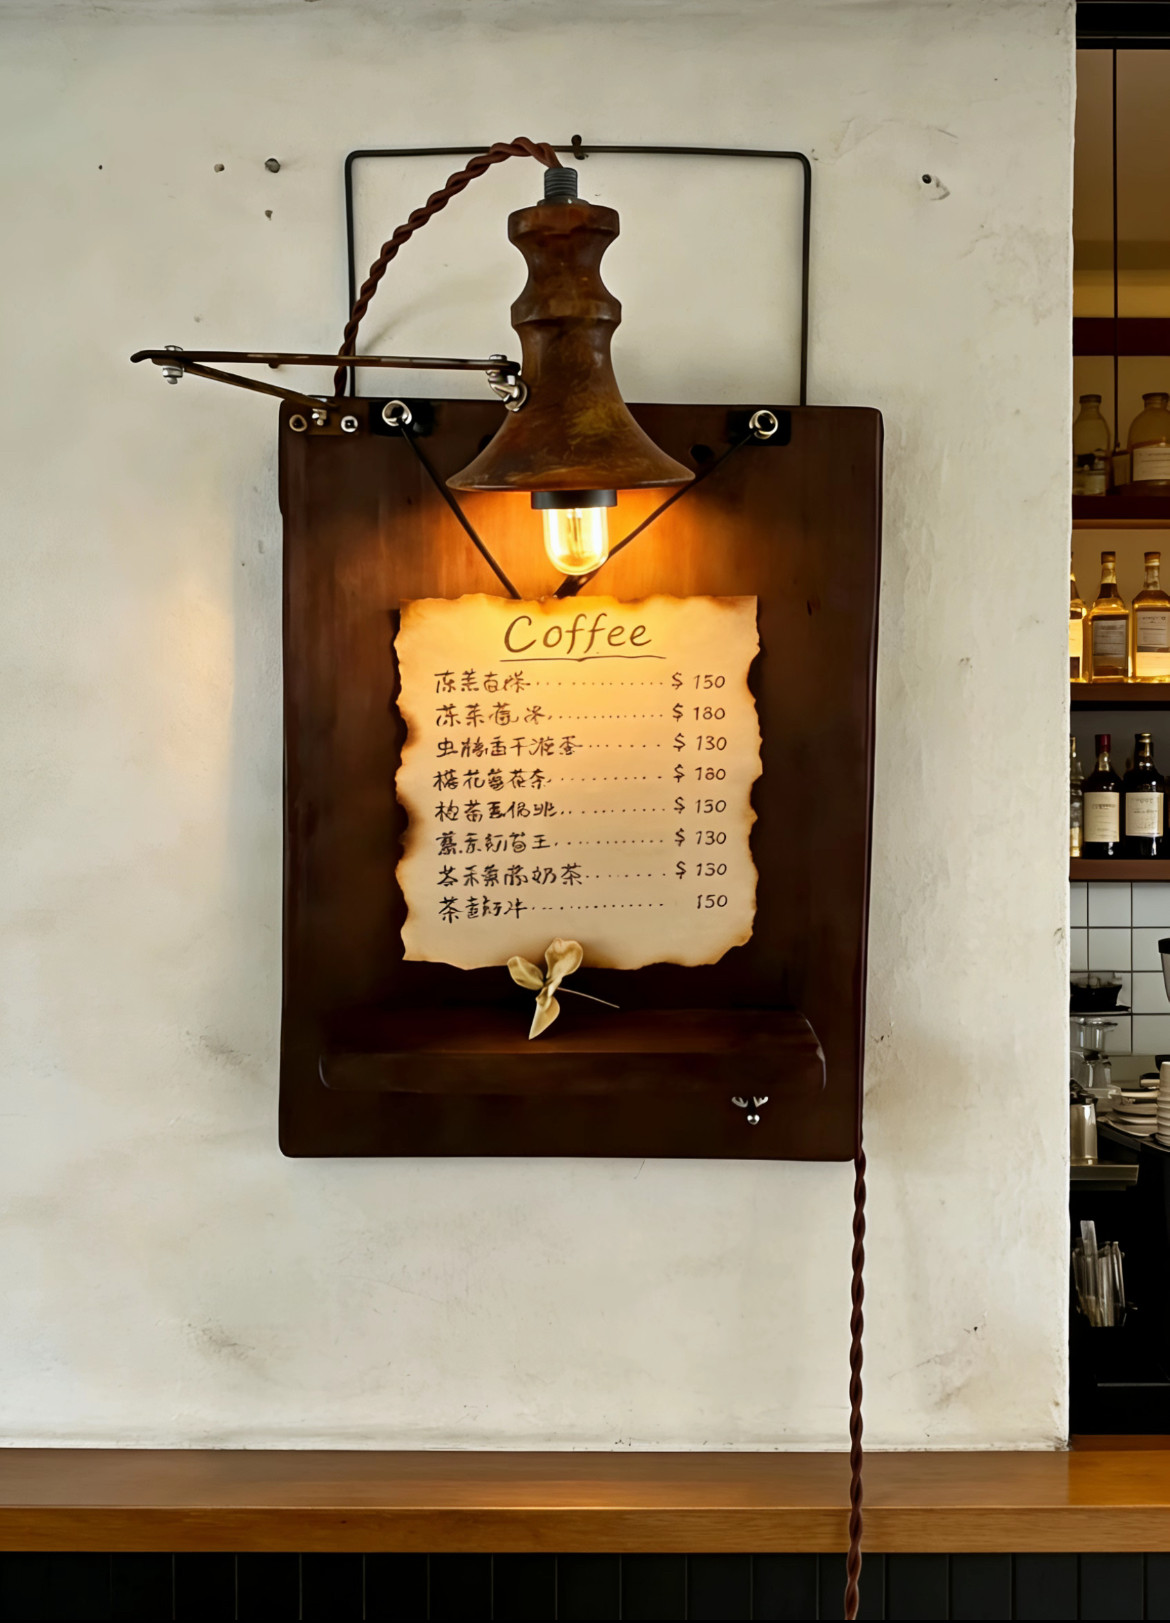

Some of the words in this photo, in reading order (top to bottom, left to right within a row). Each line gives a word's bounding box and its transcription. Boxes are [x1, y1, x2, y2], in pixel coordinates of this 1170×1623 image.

[503, 612, 653, 655] Coffee
[693, 674, 727, 690] 150
[696, 735, 728, 752] 130
[695, 830, 728, 846] 130
[696, 893, 729, 910] 150
